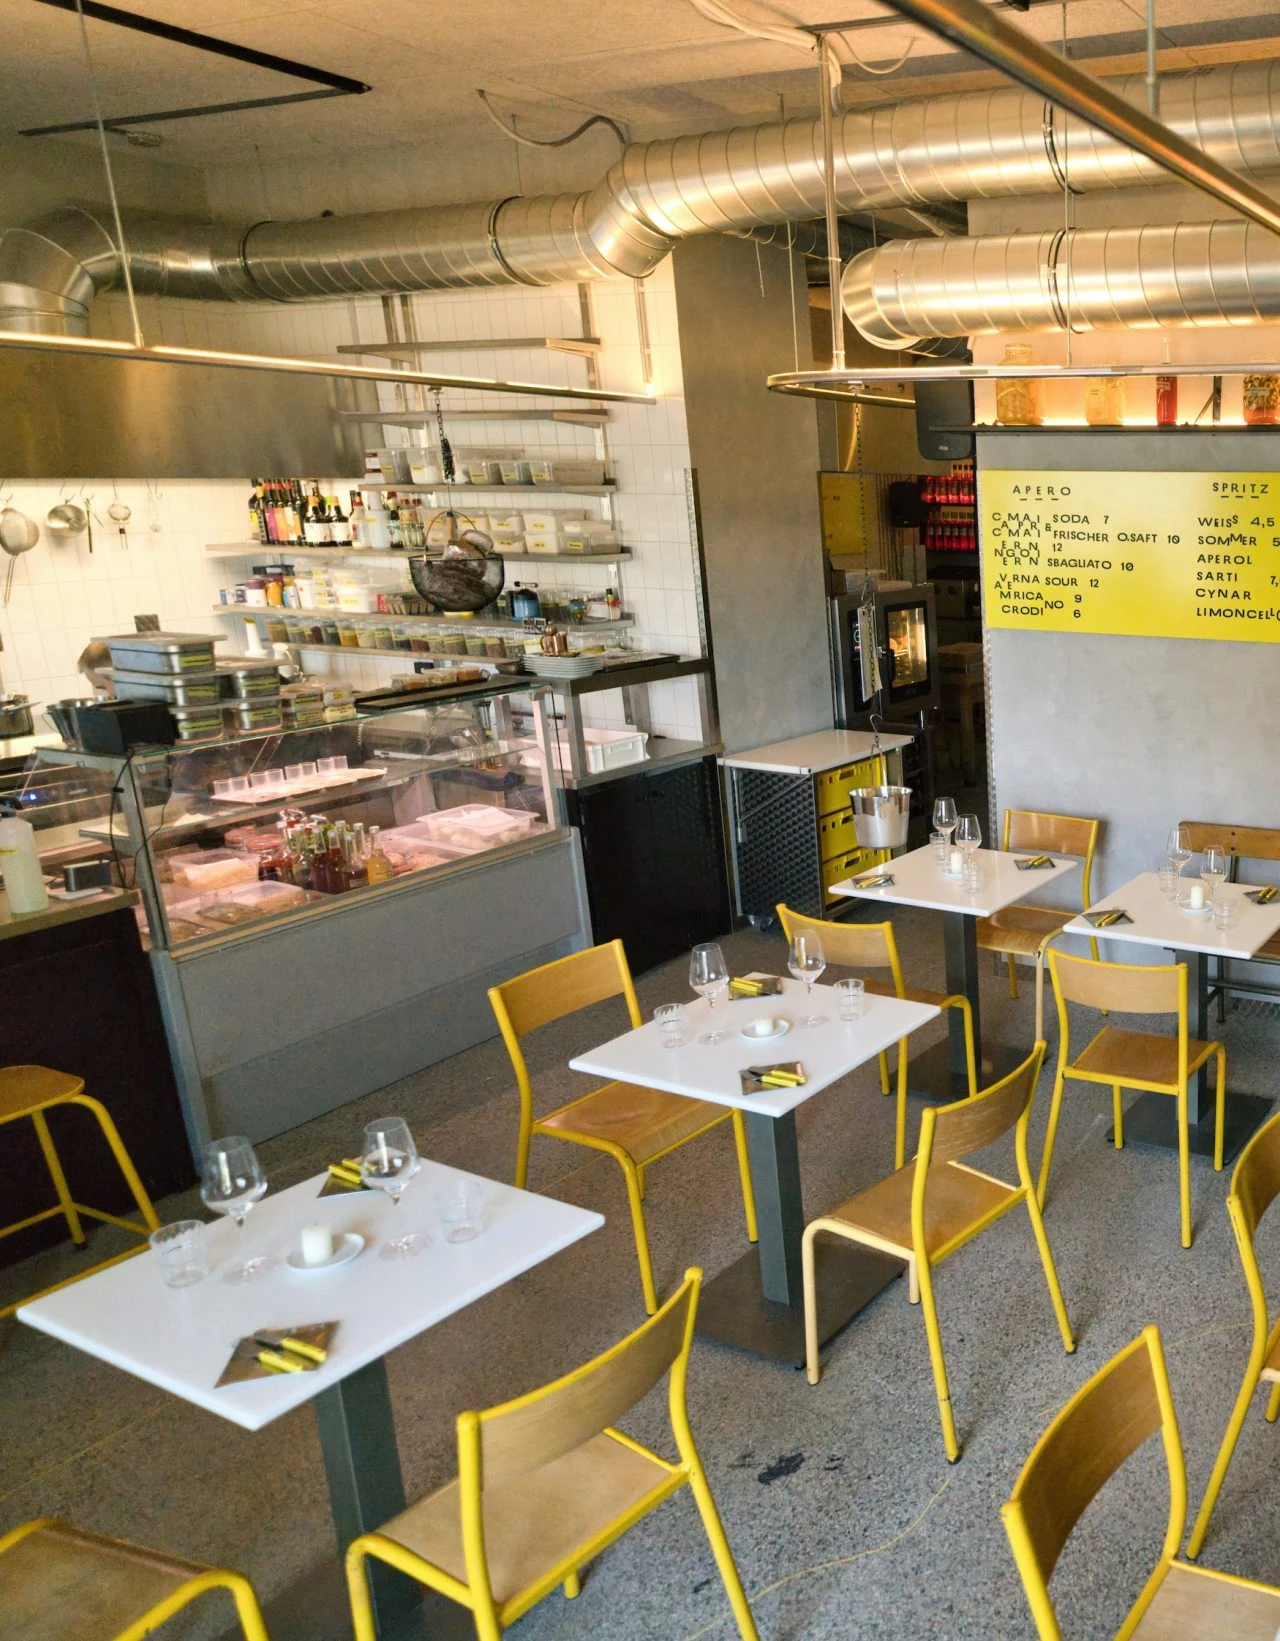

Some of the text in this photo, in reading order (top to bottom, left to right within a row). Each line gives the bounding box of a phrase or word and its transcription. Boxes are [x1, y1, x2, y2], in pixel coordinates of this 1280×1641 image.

[1012, 485, 1072, 497] APERO
[1212, 482, 1269, 494] SPRITZ
[1053, 514, 1090, 525] SODA
[1104, 515, 1110, 525] 7
[1198, 514, 1275, 529] WEISS 4,5
[1045, 523, 1051, 532] &
[1053, 531, 1109, 542] FRISCHER
[1167, 535, 1180, 544] 10
[1198, 533, 1257, 547] SOMMER
[1052, 543, 1063, 552] 12
[1047, 558, 1112, 570] SBAGLIATO
[1121, 562, 1134, 571] 10
[1197, 553, 1252, 565] APEROL
[1045, 577, 1078, 586] SOUR
[1090, 579, 1099, 588] 12
[1197, 571, 1238, 583] SARTI
[1075, 595, 1082, 603] 9
[1195, 588, 1251, 600] CYNAR
[1073, 609, 1081, 618] 6
